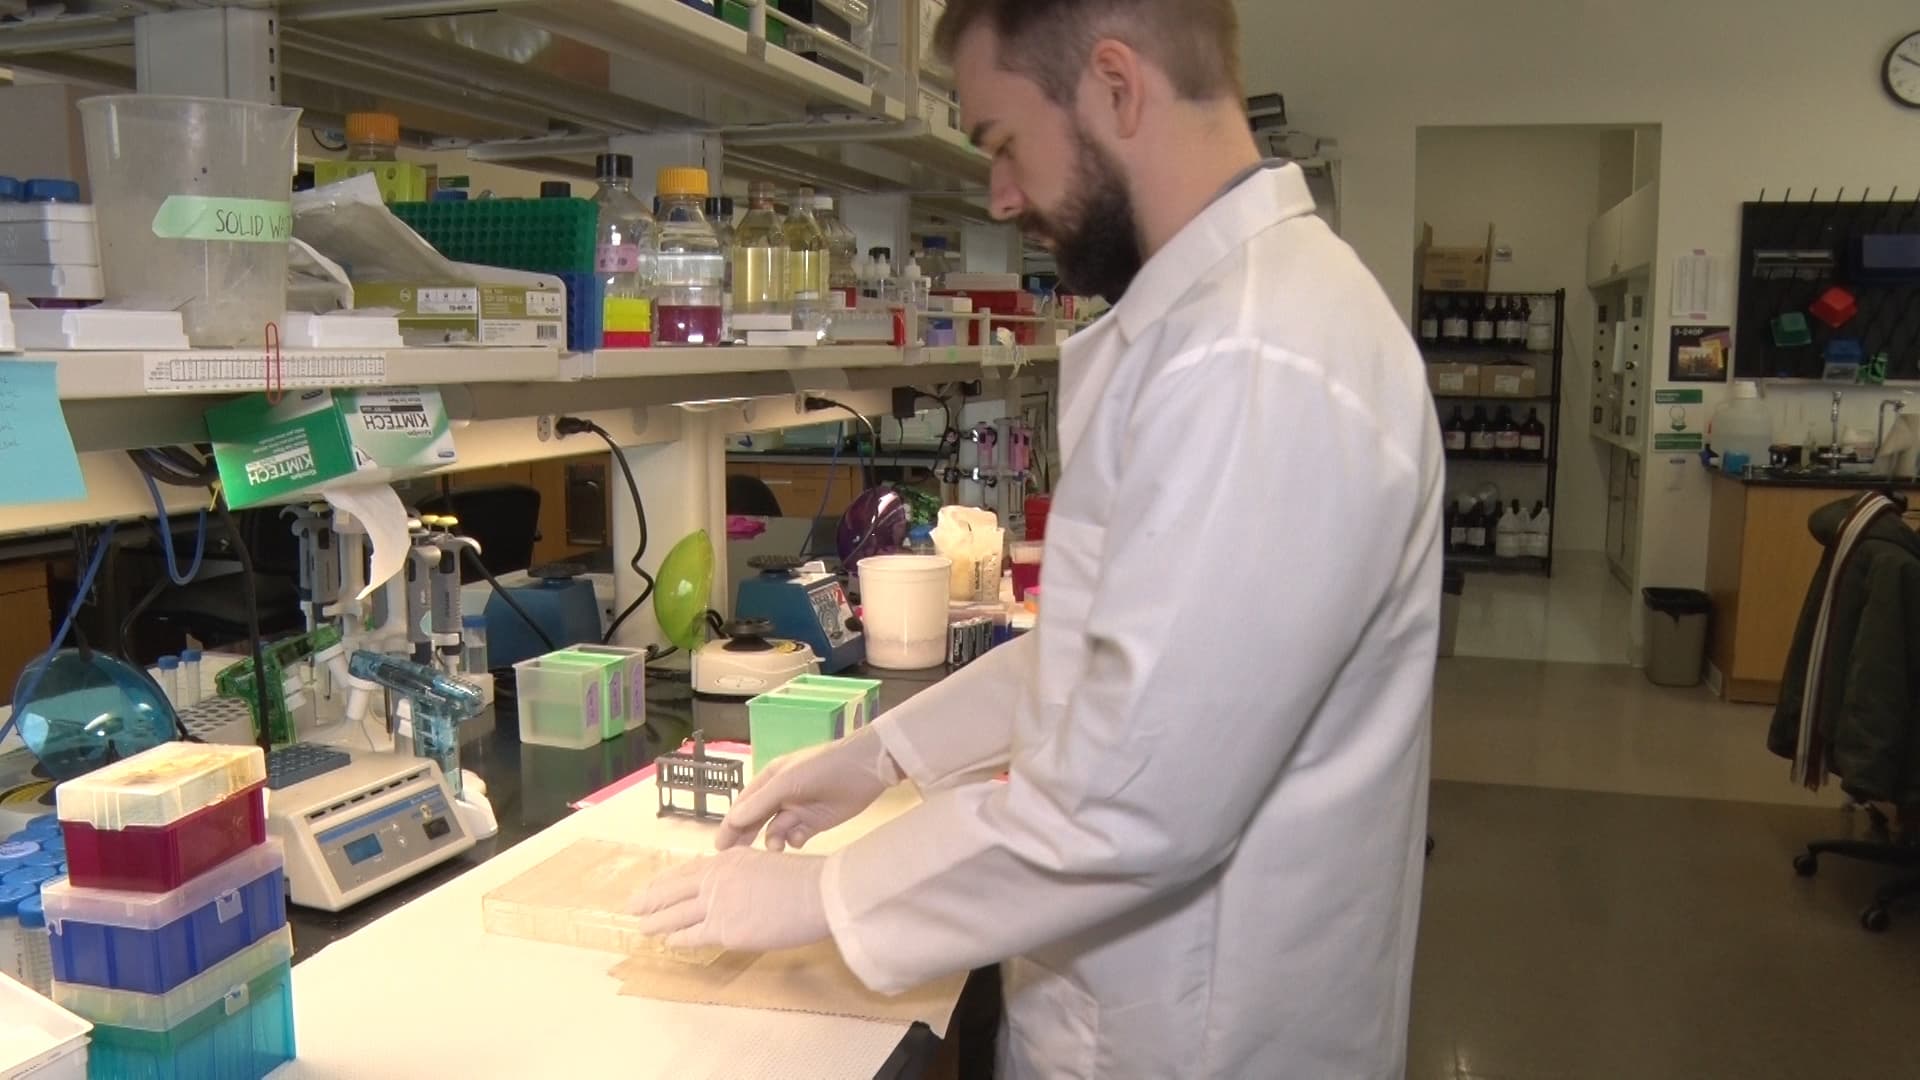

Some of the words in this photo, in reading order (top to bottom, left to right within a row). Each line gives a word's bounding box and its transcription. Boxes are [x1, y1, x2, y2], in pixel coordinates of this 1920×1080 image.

[215, 208, 264, 237] SOLID
[362, 413, 430, 431] KIMTECH
[247, 453, 315, 487] KIMTECH
